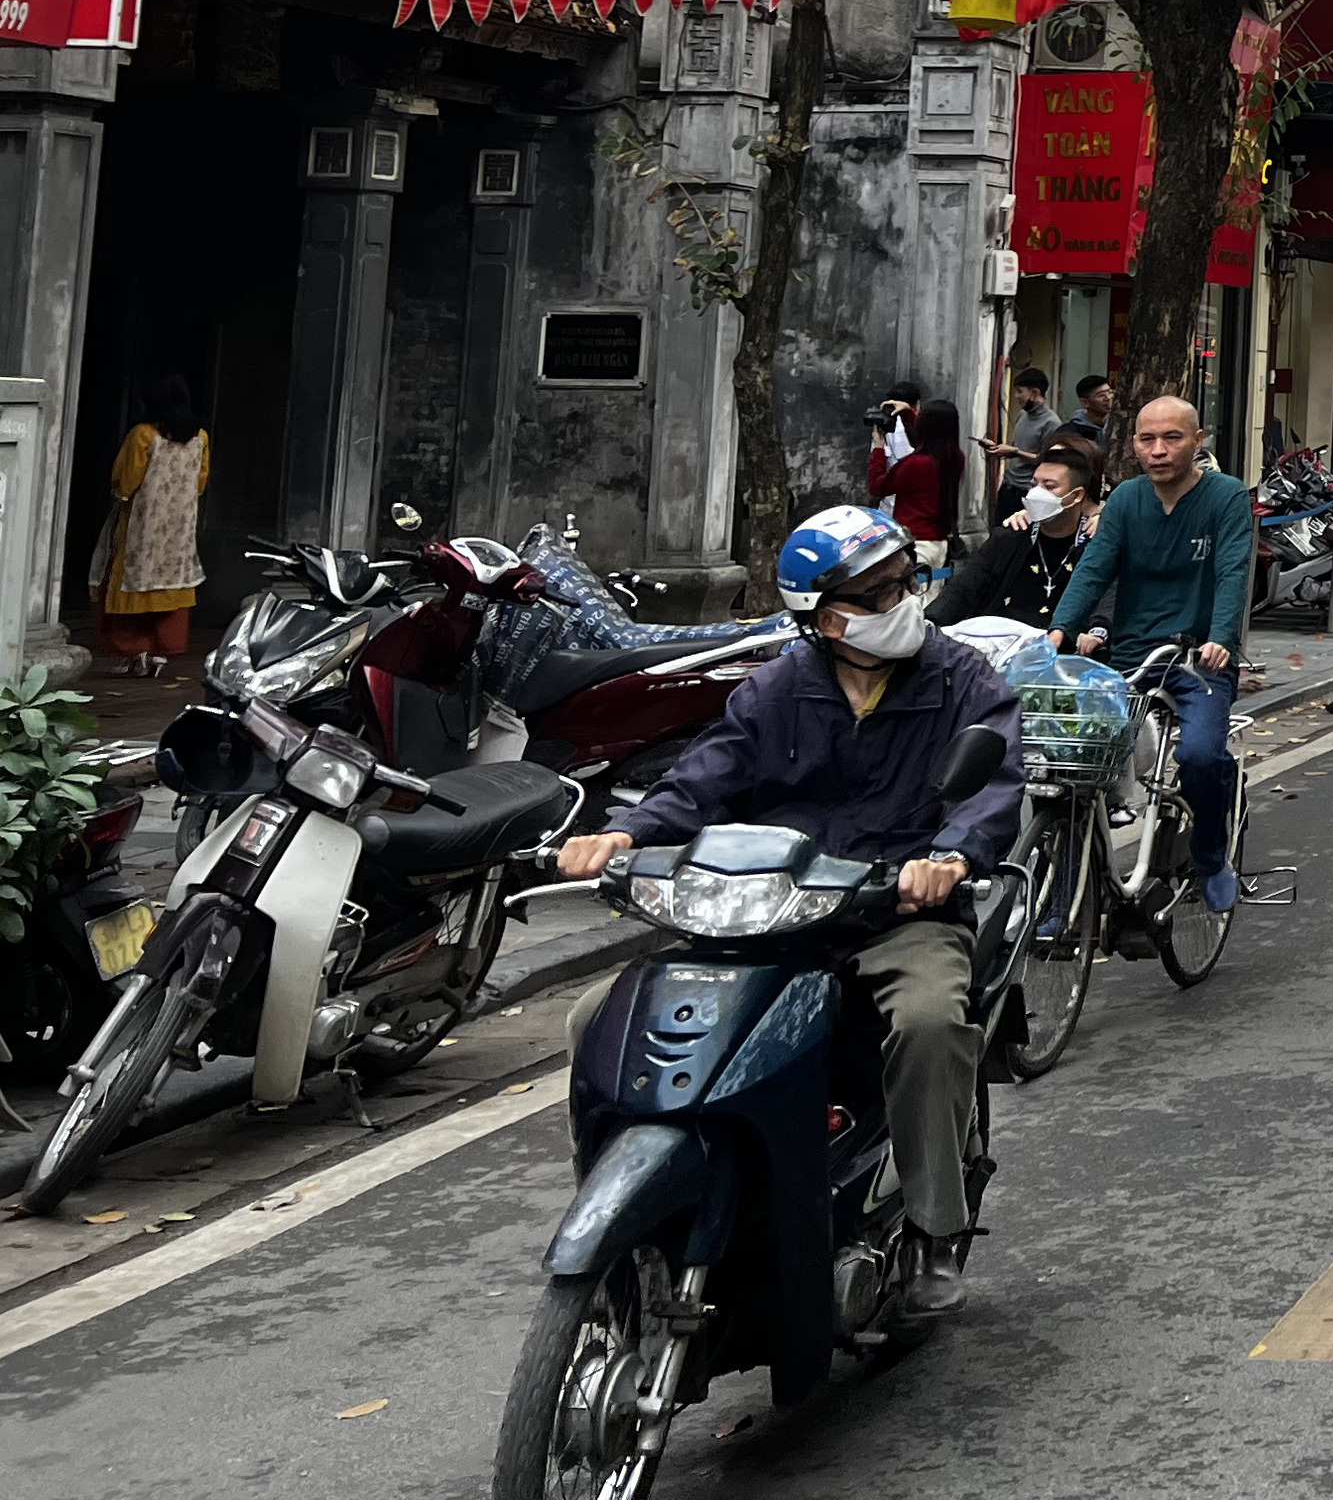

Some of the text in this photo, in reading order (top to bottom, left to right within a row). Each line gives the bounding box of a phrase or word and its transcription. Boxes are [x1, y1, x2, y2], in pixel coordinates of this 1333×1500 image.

[1044, 82, 1114, 113] VÀNG
[1043, 126, 1110, 158] TOÀN
[1035, 166, 1121, 202] THẮNG
